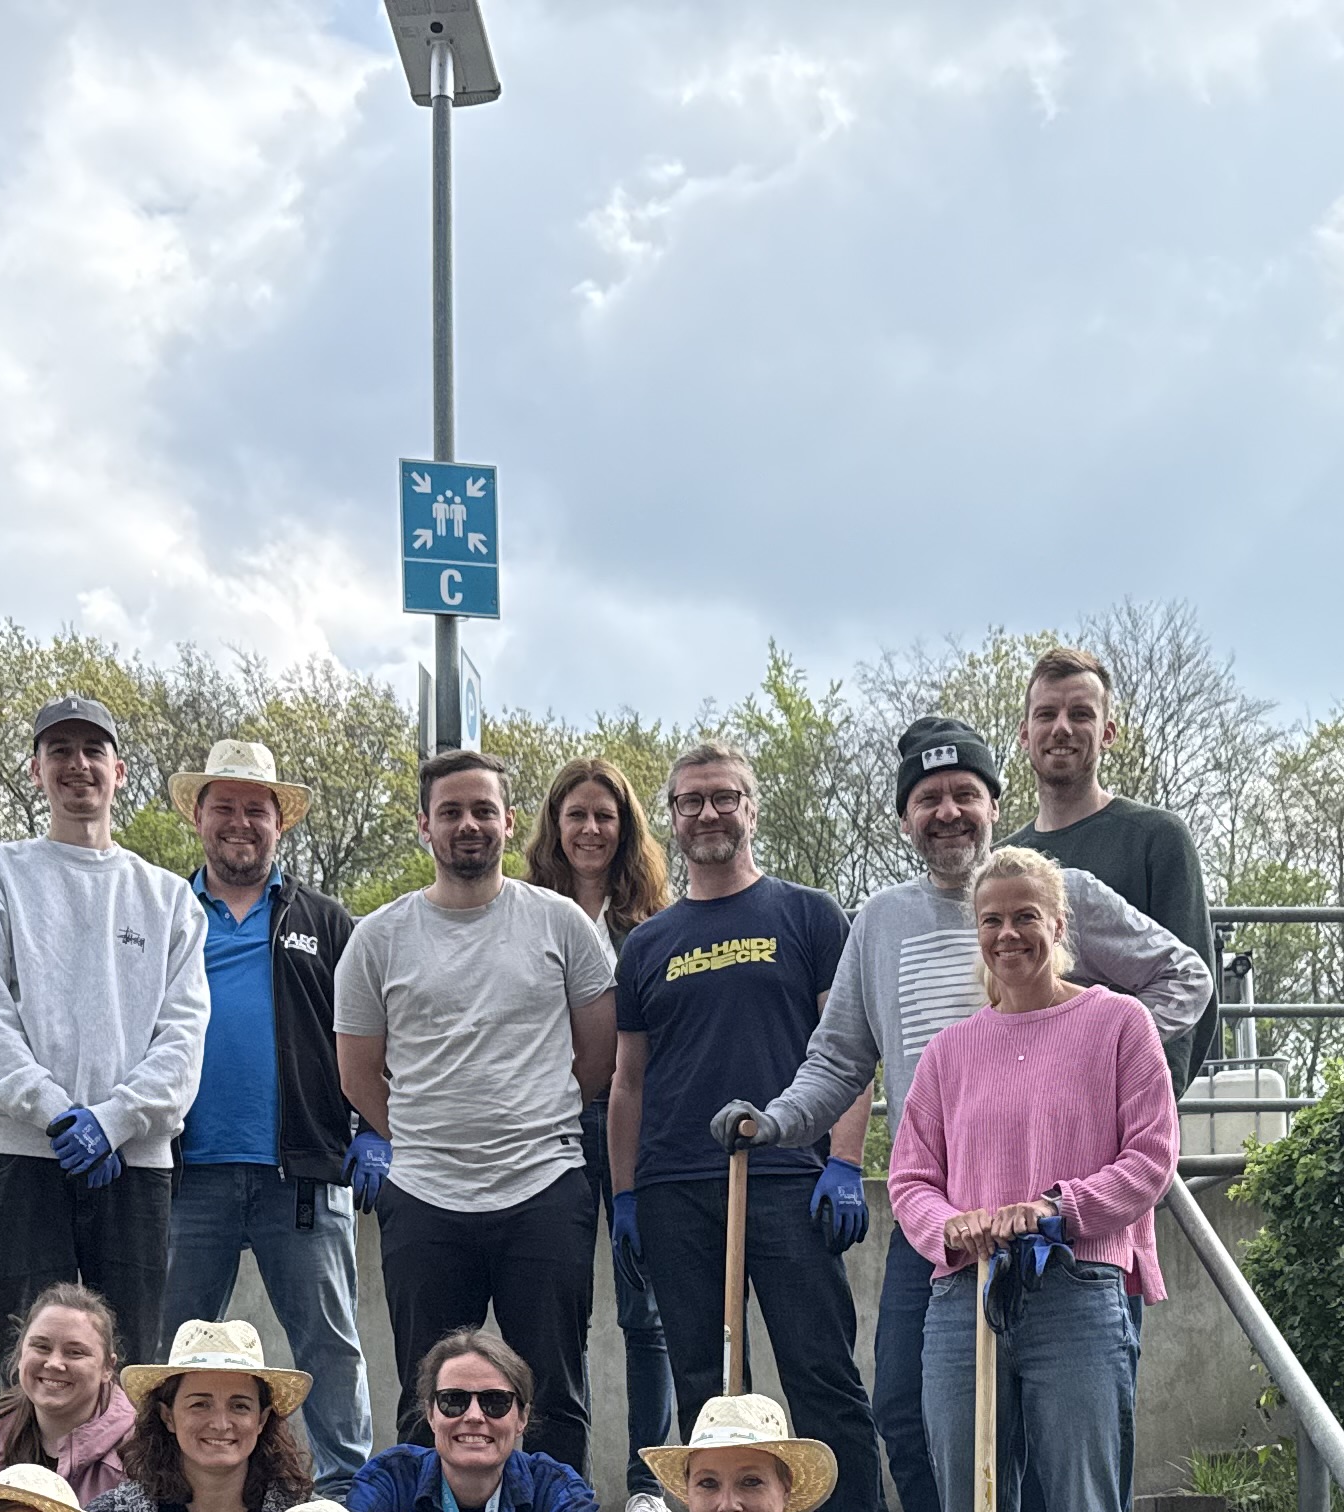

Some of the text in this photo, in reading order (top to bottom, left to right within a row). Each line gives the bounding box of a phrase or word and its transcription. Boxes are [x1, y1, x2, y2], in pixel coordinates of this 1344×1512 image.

[439, 568, 463, 606] C
[665, 949, 777, 981] ON DECK
[666, 937, 777, 972] ALL HANDS
